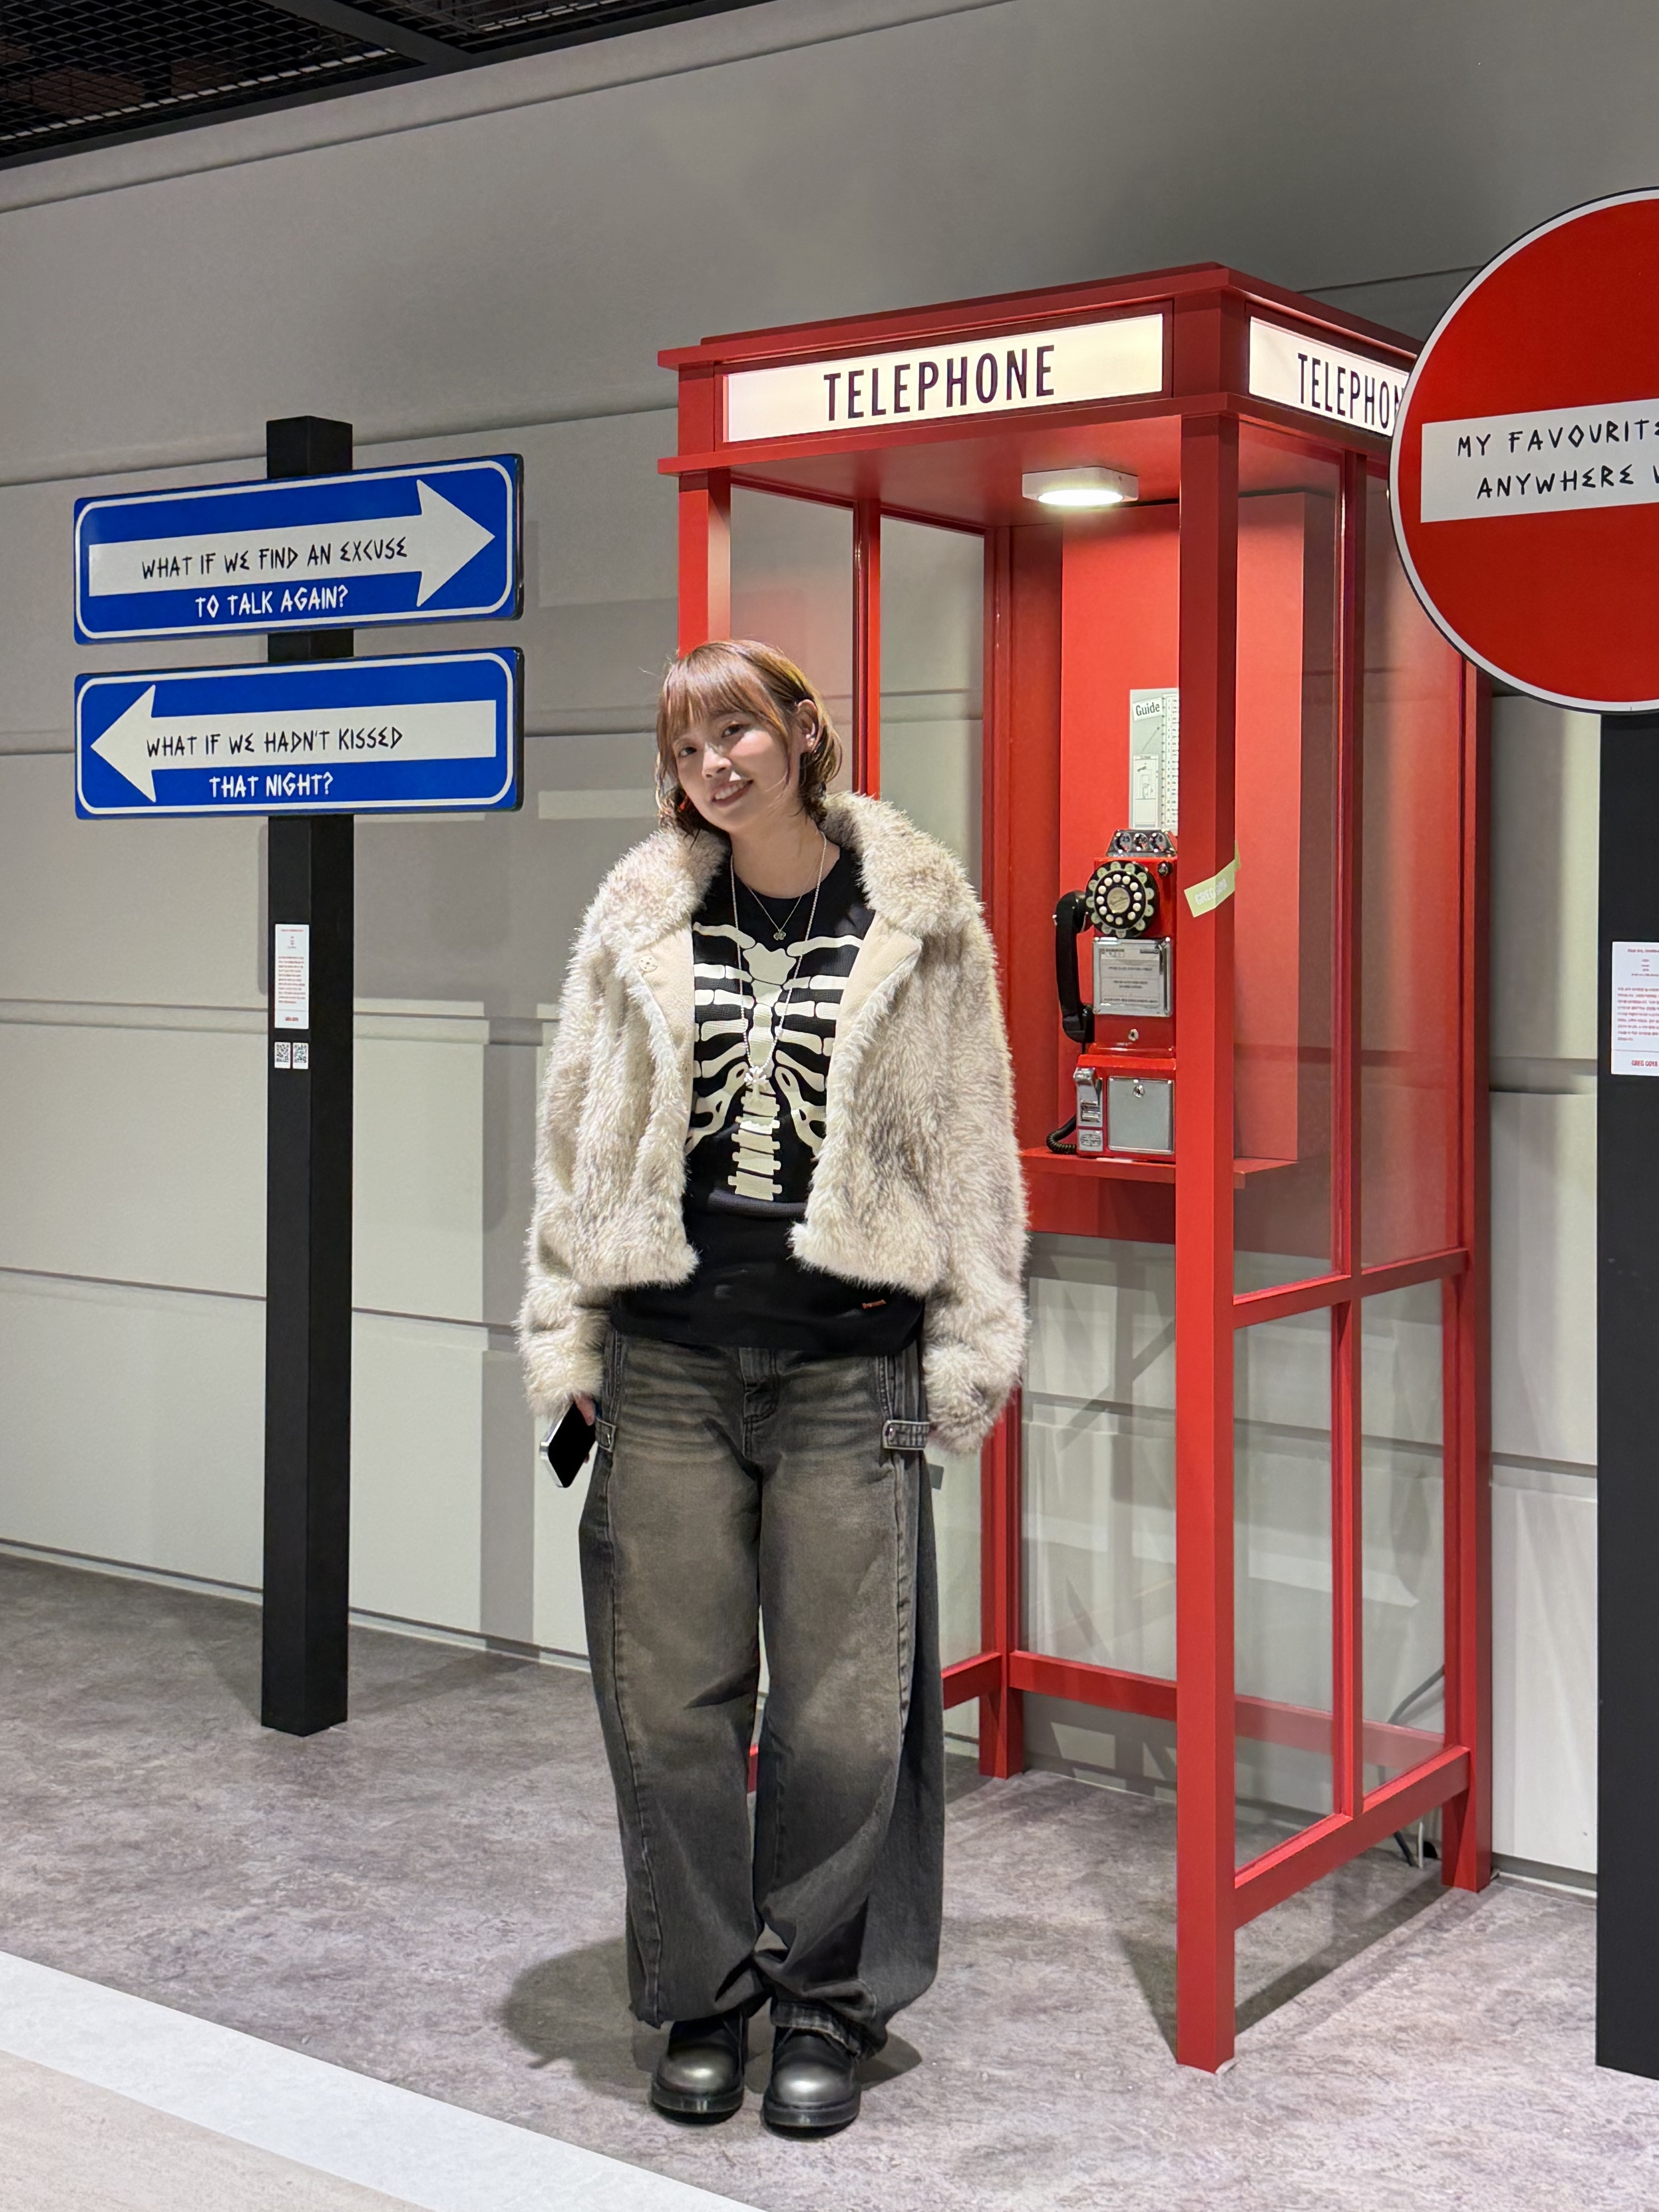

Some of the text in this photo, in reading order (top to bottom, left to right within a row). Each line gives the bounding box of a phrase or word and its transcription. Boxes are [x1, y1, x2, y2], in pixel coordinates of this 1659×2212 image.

[823, 344, 1055, 421] TELEPHONE
[1457, 433, 1491, 458] MY
[1477, 464, 1635, 500] ANYWHERE
[141, 536, 408, 579] WHAT IF WE FIND AN EXCUSE
[195, 584, 349, 618] TO TALK AGAIN?
[1136, 702, 1161, 717] Guide
[147, 726, 404, 757] WHAT IF WE HADN'T KISSED
[209, 771, 333, 798] THAT NIGHT?
